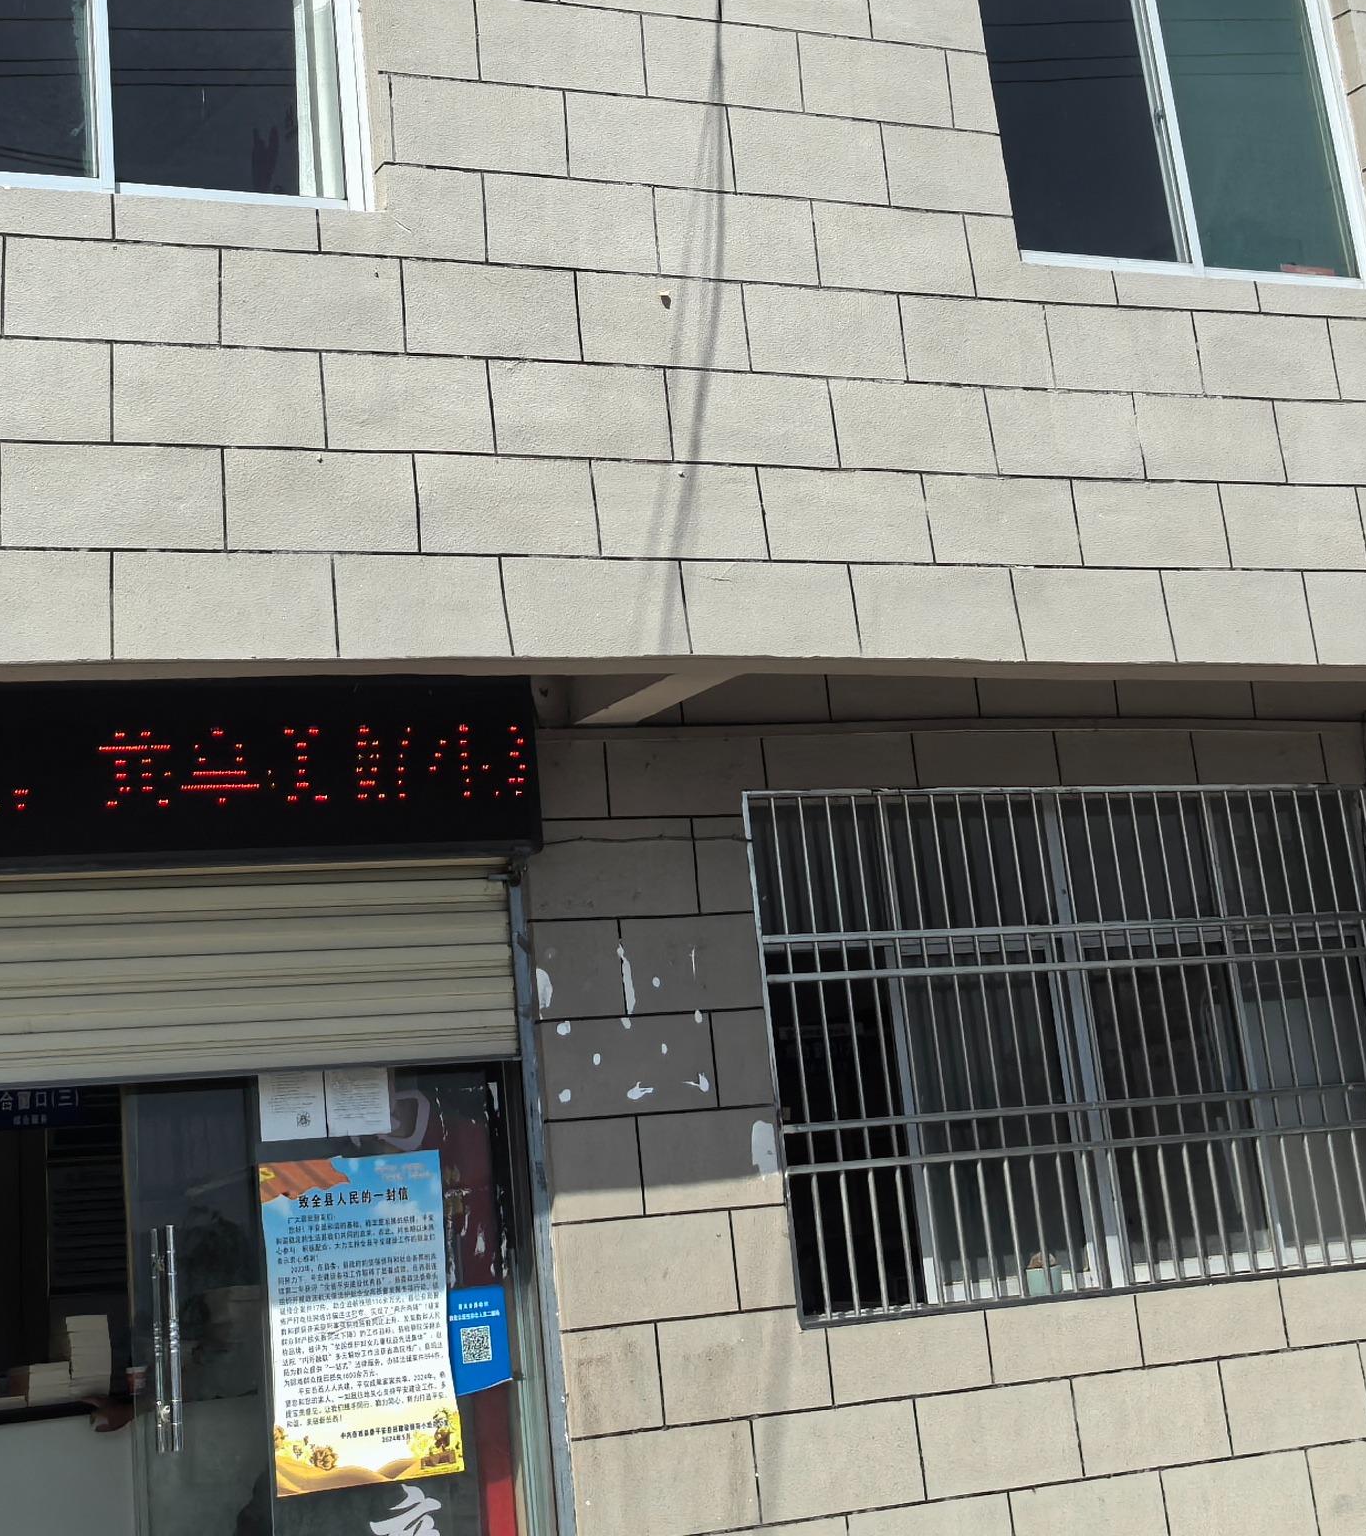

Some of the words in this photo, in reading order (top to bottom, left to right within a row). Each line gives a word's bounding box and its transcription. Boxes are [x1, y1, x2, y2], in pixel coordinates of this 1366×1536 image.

[298, 1186, 409, 1209] 致全县人民的一封信
